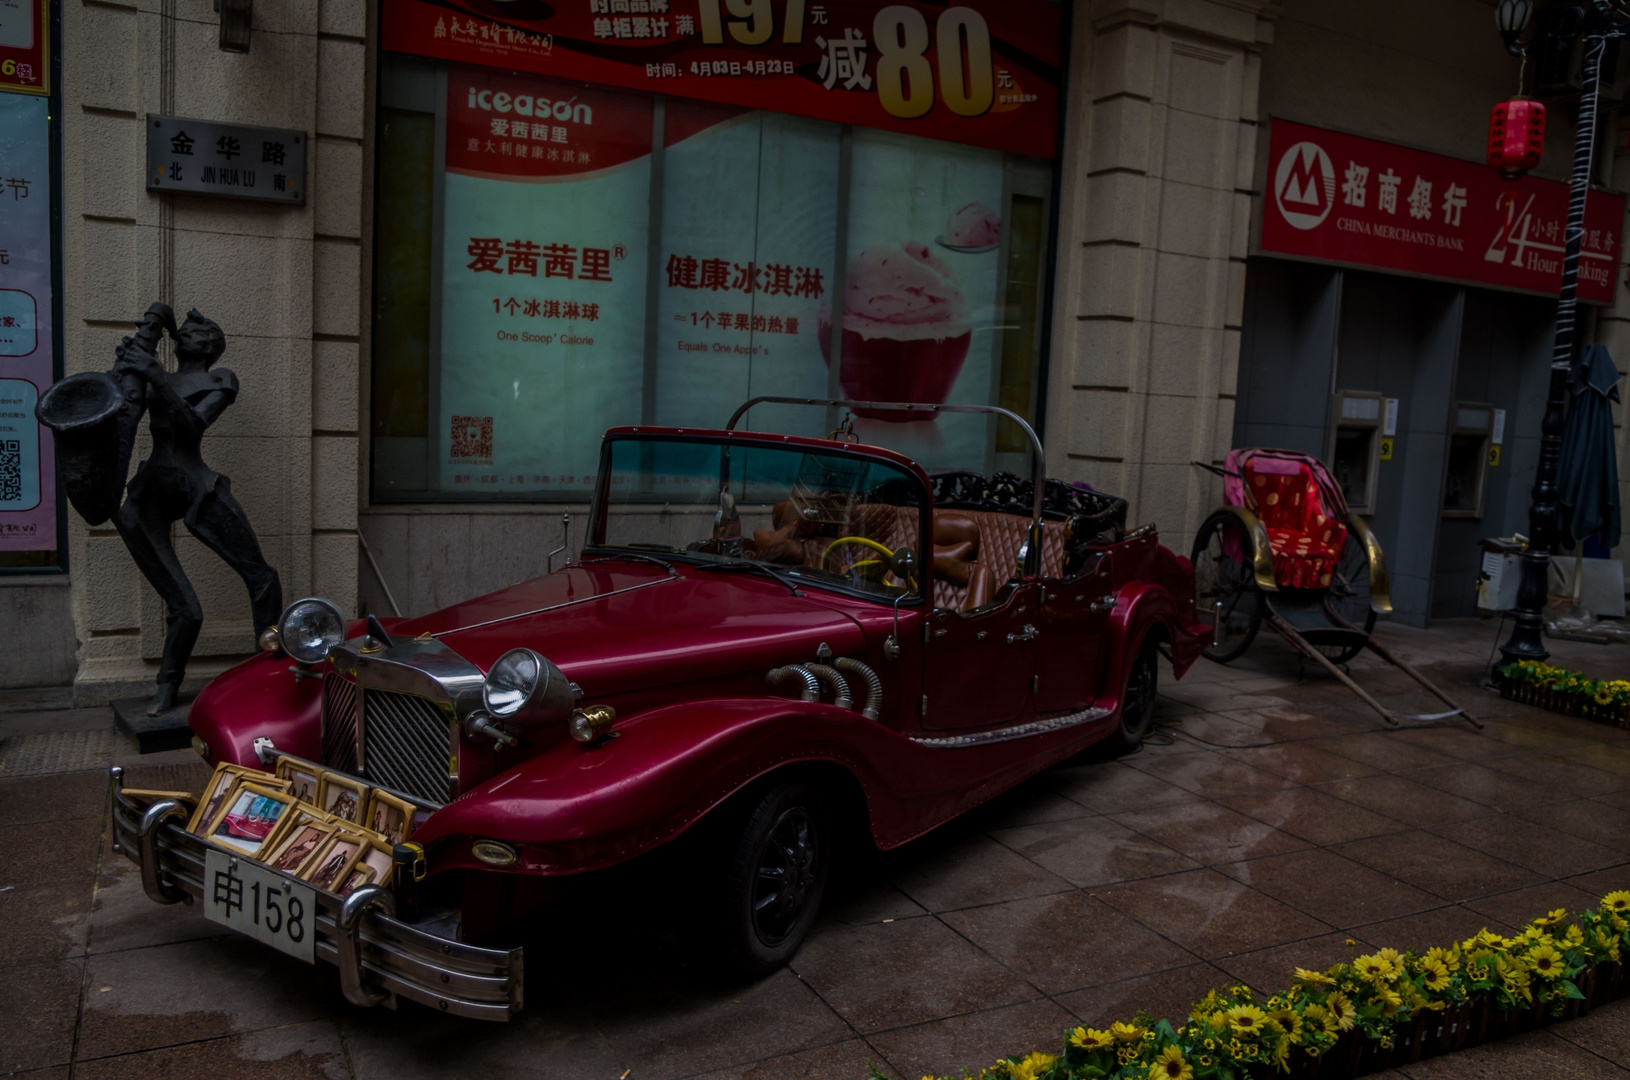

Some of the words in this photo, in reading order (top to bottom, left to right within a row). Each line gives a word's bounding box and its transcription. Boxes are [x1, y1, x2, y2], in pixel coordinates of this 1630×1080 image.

[593, 17, 669, 39] 单柜累计
[675, 14, 695, 36] 满
[811, 6, 828, 26] 元
[815, 28, 872, 91] 减
[872, 4, 996, 119] 80
[998, 70, 1013, 89] 元
[490, 118, 569, 144] 爱茜茜里
[170, 130, 287, 166] 金华路
[466, 138, 592, 165] 意大利健康冰淇淋
[169, 162, 183, 182] 北
[201, 166, 216, 184] JIN
[219, 168, 239, 187] HUA
[243, 171, 255, 188] LU
[273, 174, 286, 192] 南
[1336, 215, 1372, 236] CHINA
[1372, 223, 1436, 248] MERCHANTS
[1436, 235, 1465, 253] BANK
[1483, 191, 1537, 268] 24
[666, 253, 824, 300] 健康冰淇淋
[1526, 250, 1560, 275] Hour
[493, 297, 600, 322] 1个冰淇淋球
[497, 330, 519, 342] One
[560, 334, 595, 346] Calorie
[677, 340, 708, 353] Equals
[712, 342, 732, 354] One
[214, 863, 304, 943] 申158
